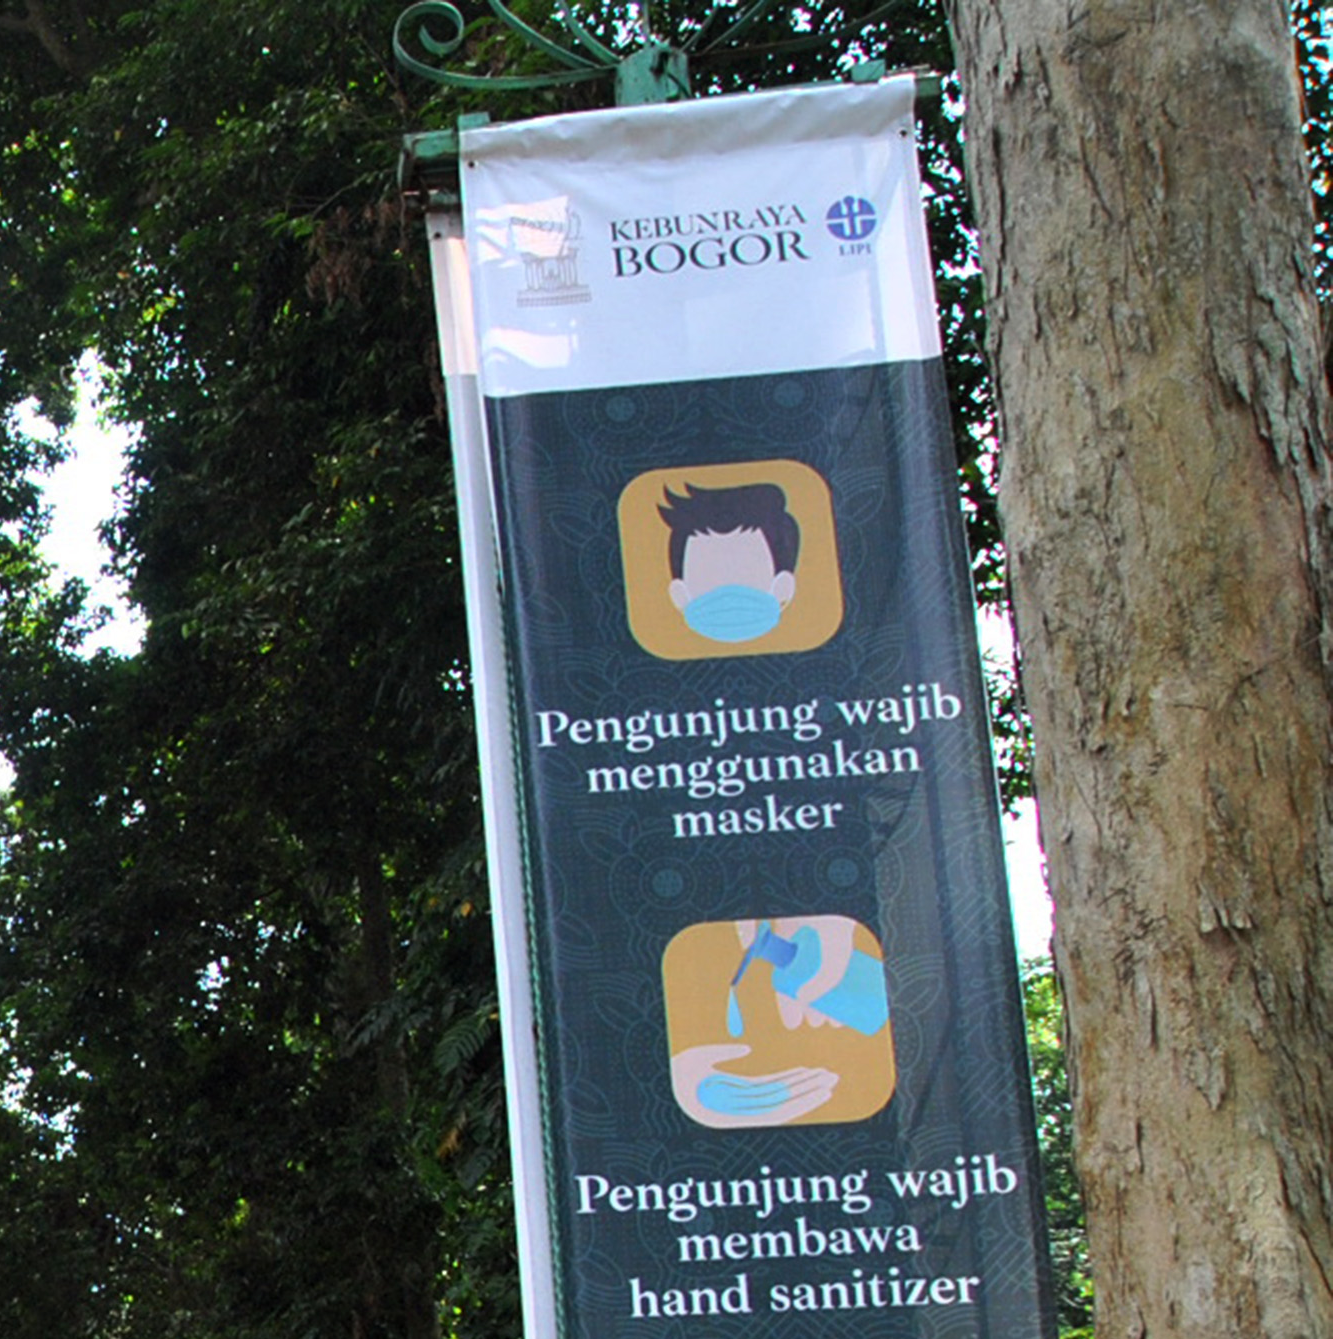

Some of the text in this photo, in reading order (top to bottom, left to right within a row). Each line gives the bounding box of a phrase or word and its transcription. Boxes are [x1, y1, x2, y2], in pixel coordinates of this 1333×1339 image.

[609, 203, 807, 243] KEBUNRAYA
[613, 230, 810, 278] BOGOR
[536, 683, 961, 753] Pengunjung wajib
[586, 739, 921, 799] menggunakan
[672, 795, 844, 838] masker
[575, 1154, 1018, 1222] Pengunjung wajib
[678, 1218, 923, 1262] membawa
[629, 1267, 981, 1318] hand sanitizer
